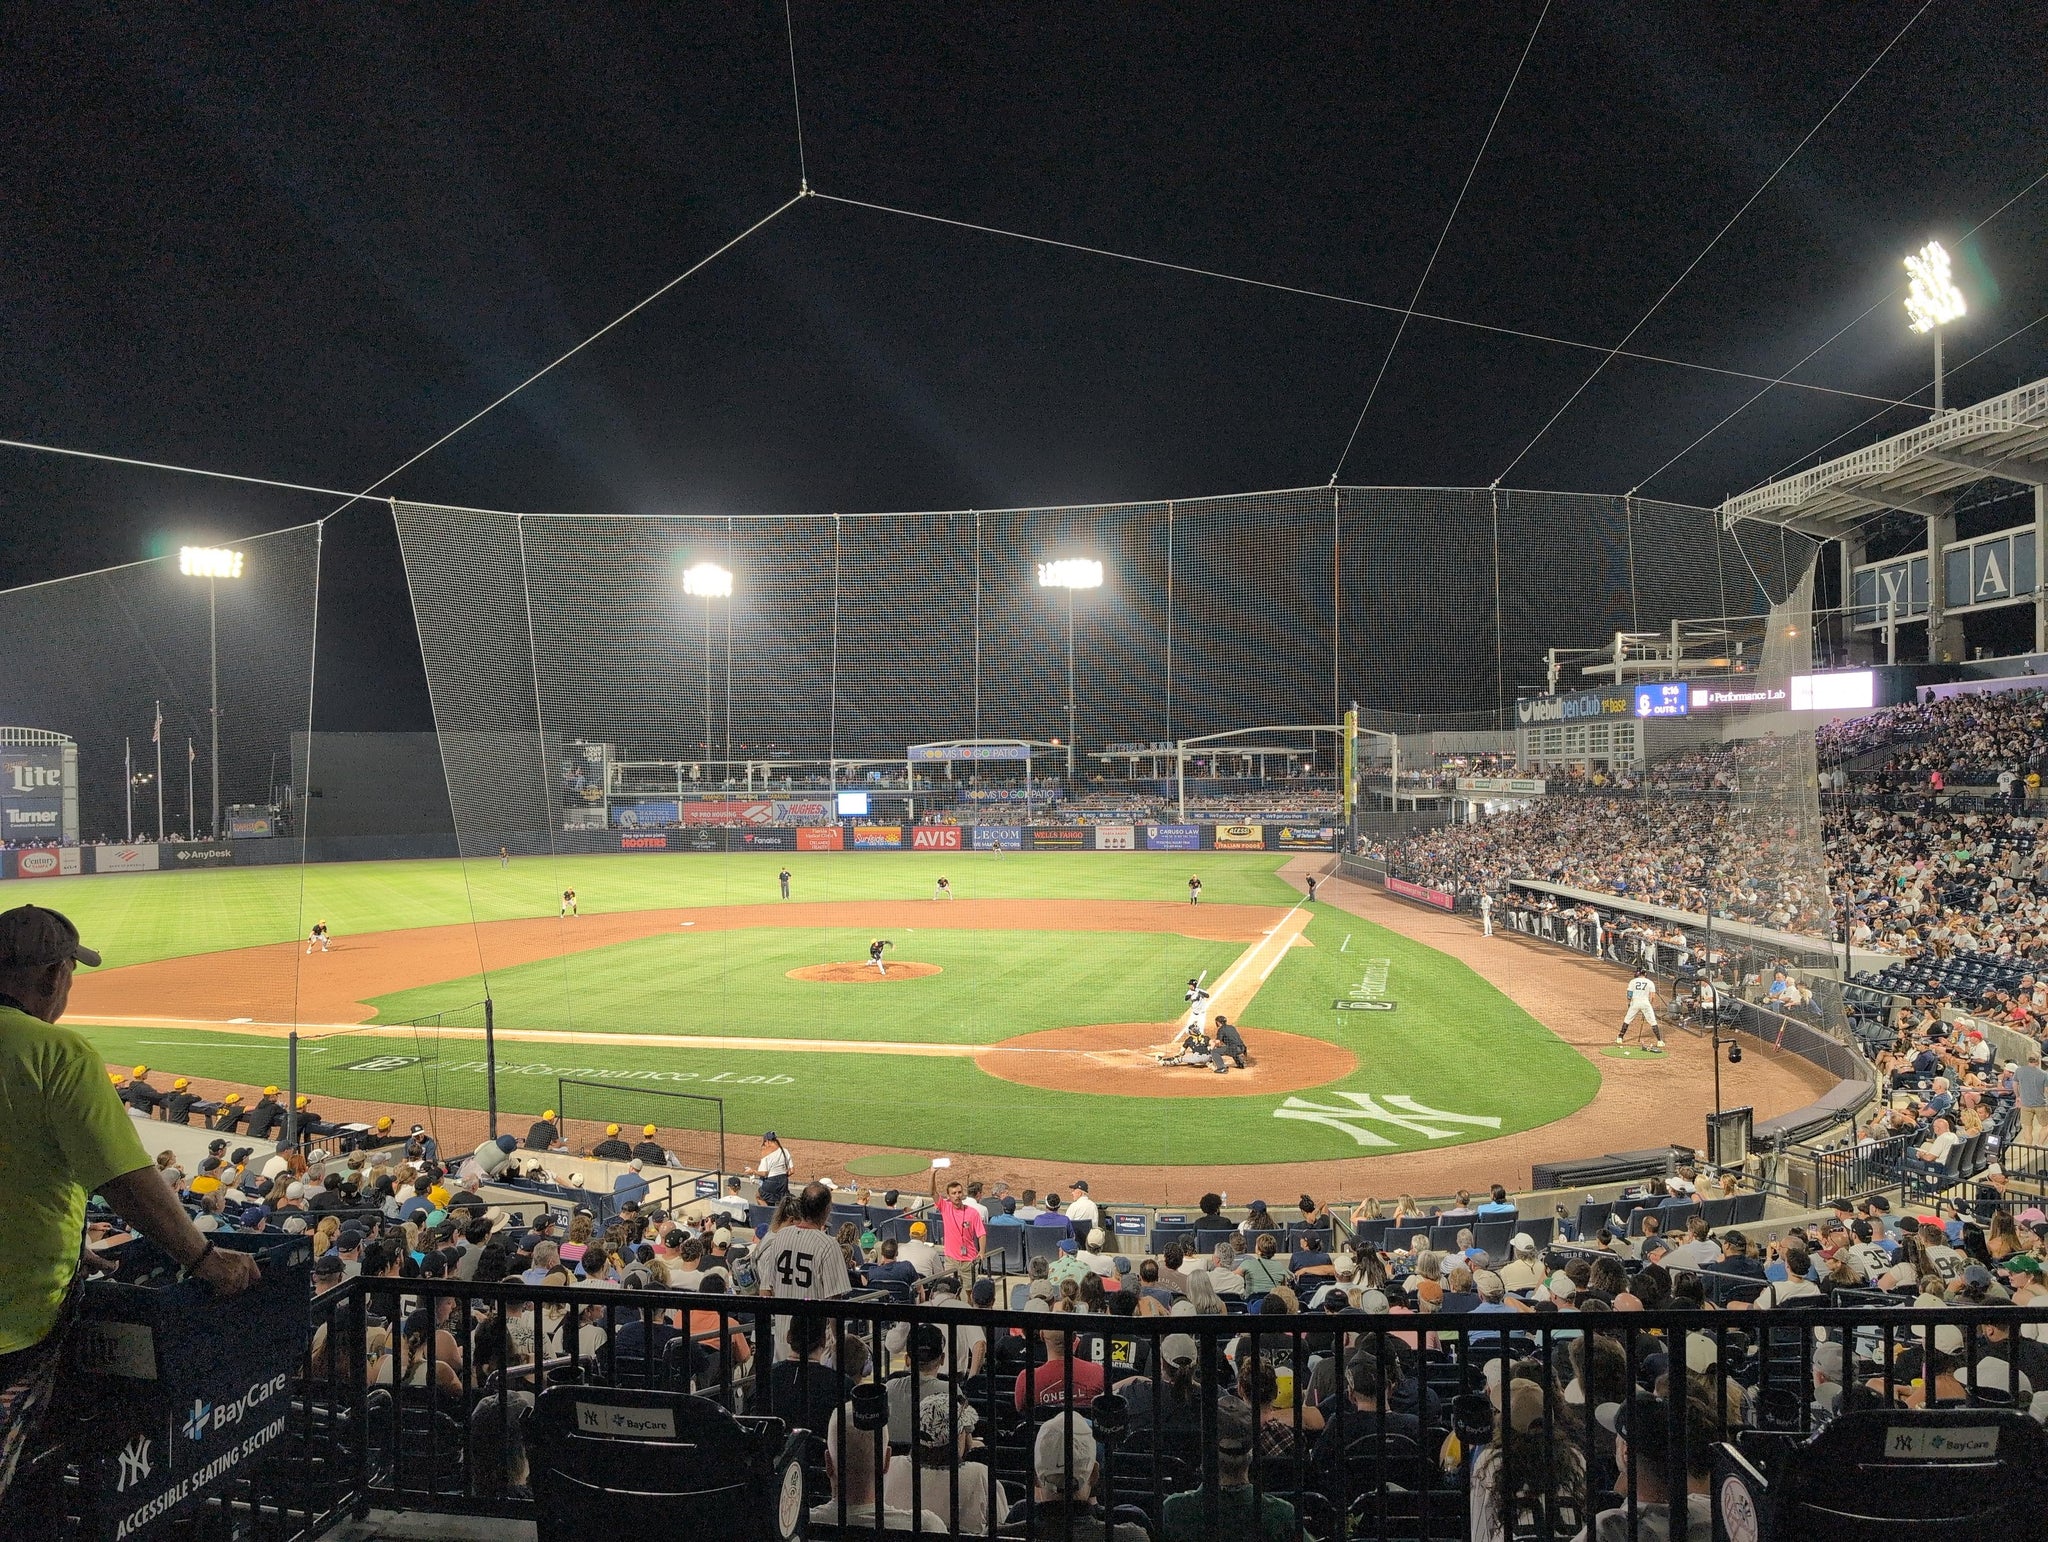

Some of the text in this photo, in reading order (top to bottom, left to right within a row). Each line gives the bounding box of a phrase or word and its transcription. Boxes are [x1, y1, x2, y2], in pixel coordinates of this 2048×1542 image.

[1976, 549, 2008, 596] A
[1880, 569, 1907, 611] Y
[1713, 690, 1786, 703] Performance Lab
[1580, 695, 1600, 716] Club
[13, 765, 61, 792] Lite
[6, 808, 58, 823] Turner
[789, 804, 823, 814] HUGHES
[754, 836, 780, 844] Fanatics
[914, 832, 956, 847] AVIS
[974, 830, 1019, 839] LECOM
[622, 838, 666, 848] HOOTERS
[191, 850, 231, 859] AnyDesk
[23, 858, 54, 868] Century
[1635, 982, 1647, 990] 27
[703, 1072, 794, 1085] Lab
[1863, 1251, 1892, 1270] 35
[777, 1249, 813, 1288] 45
[214, 1373, 286, 1430] BayCare
[627, 1419, 667, 1430] BayCare
[1946, 1440, 1989, 1450] BayCare
[116, 1416, 285, 1542] ACCESSIBLE SEATING SECTION
